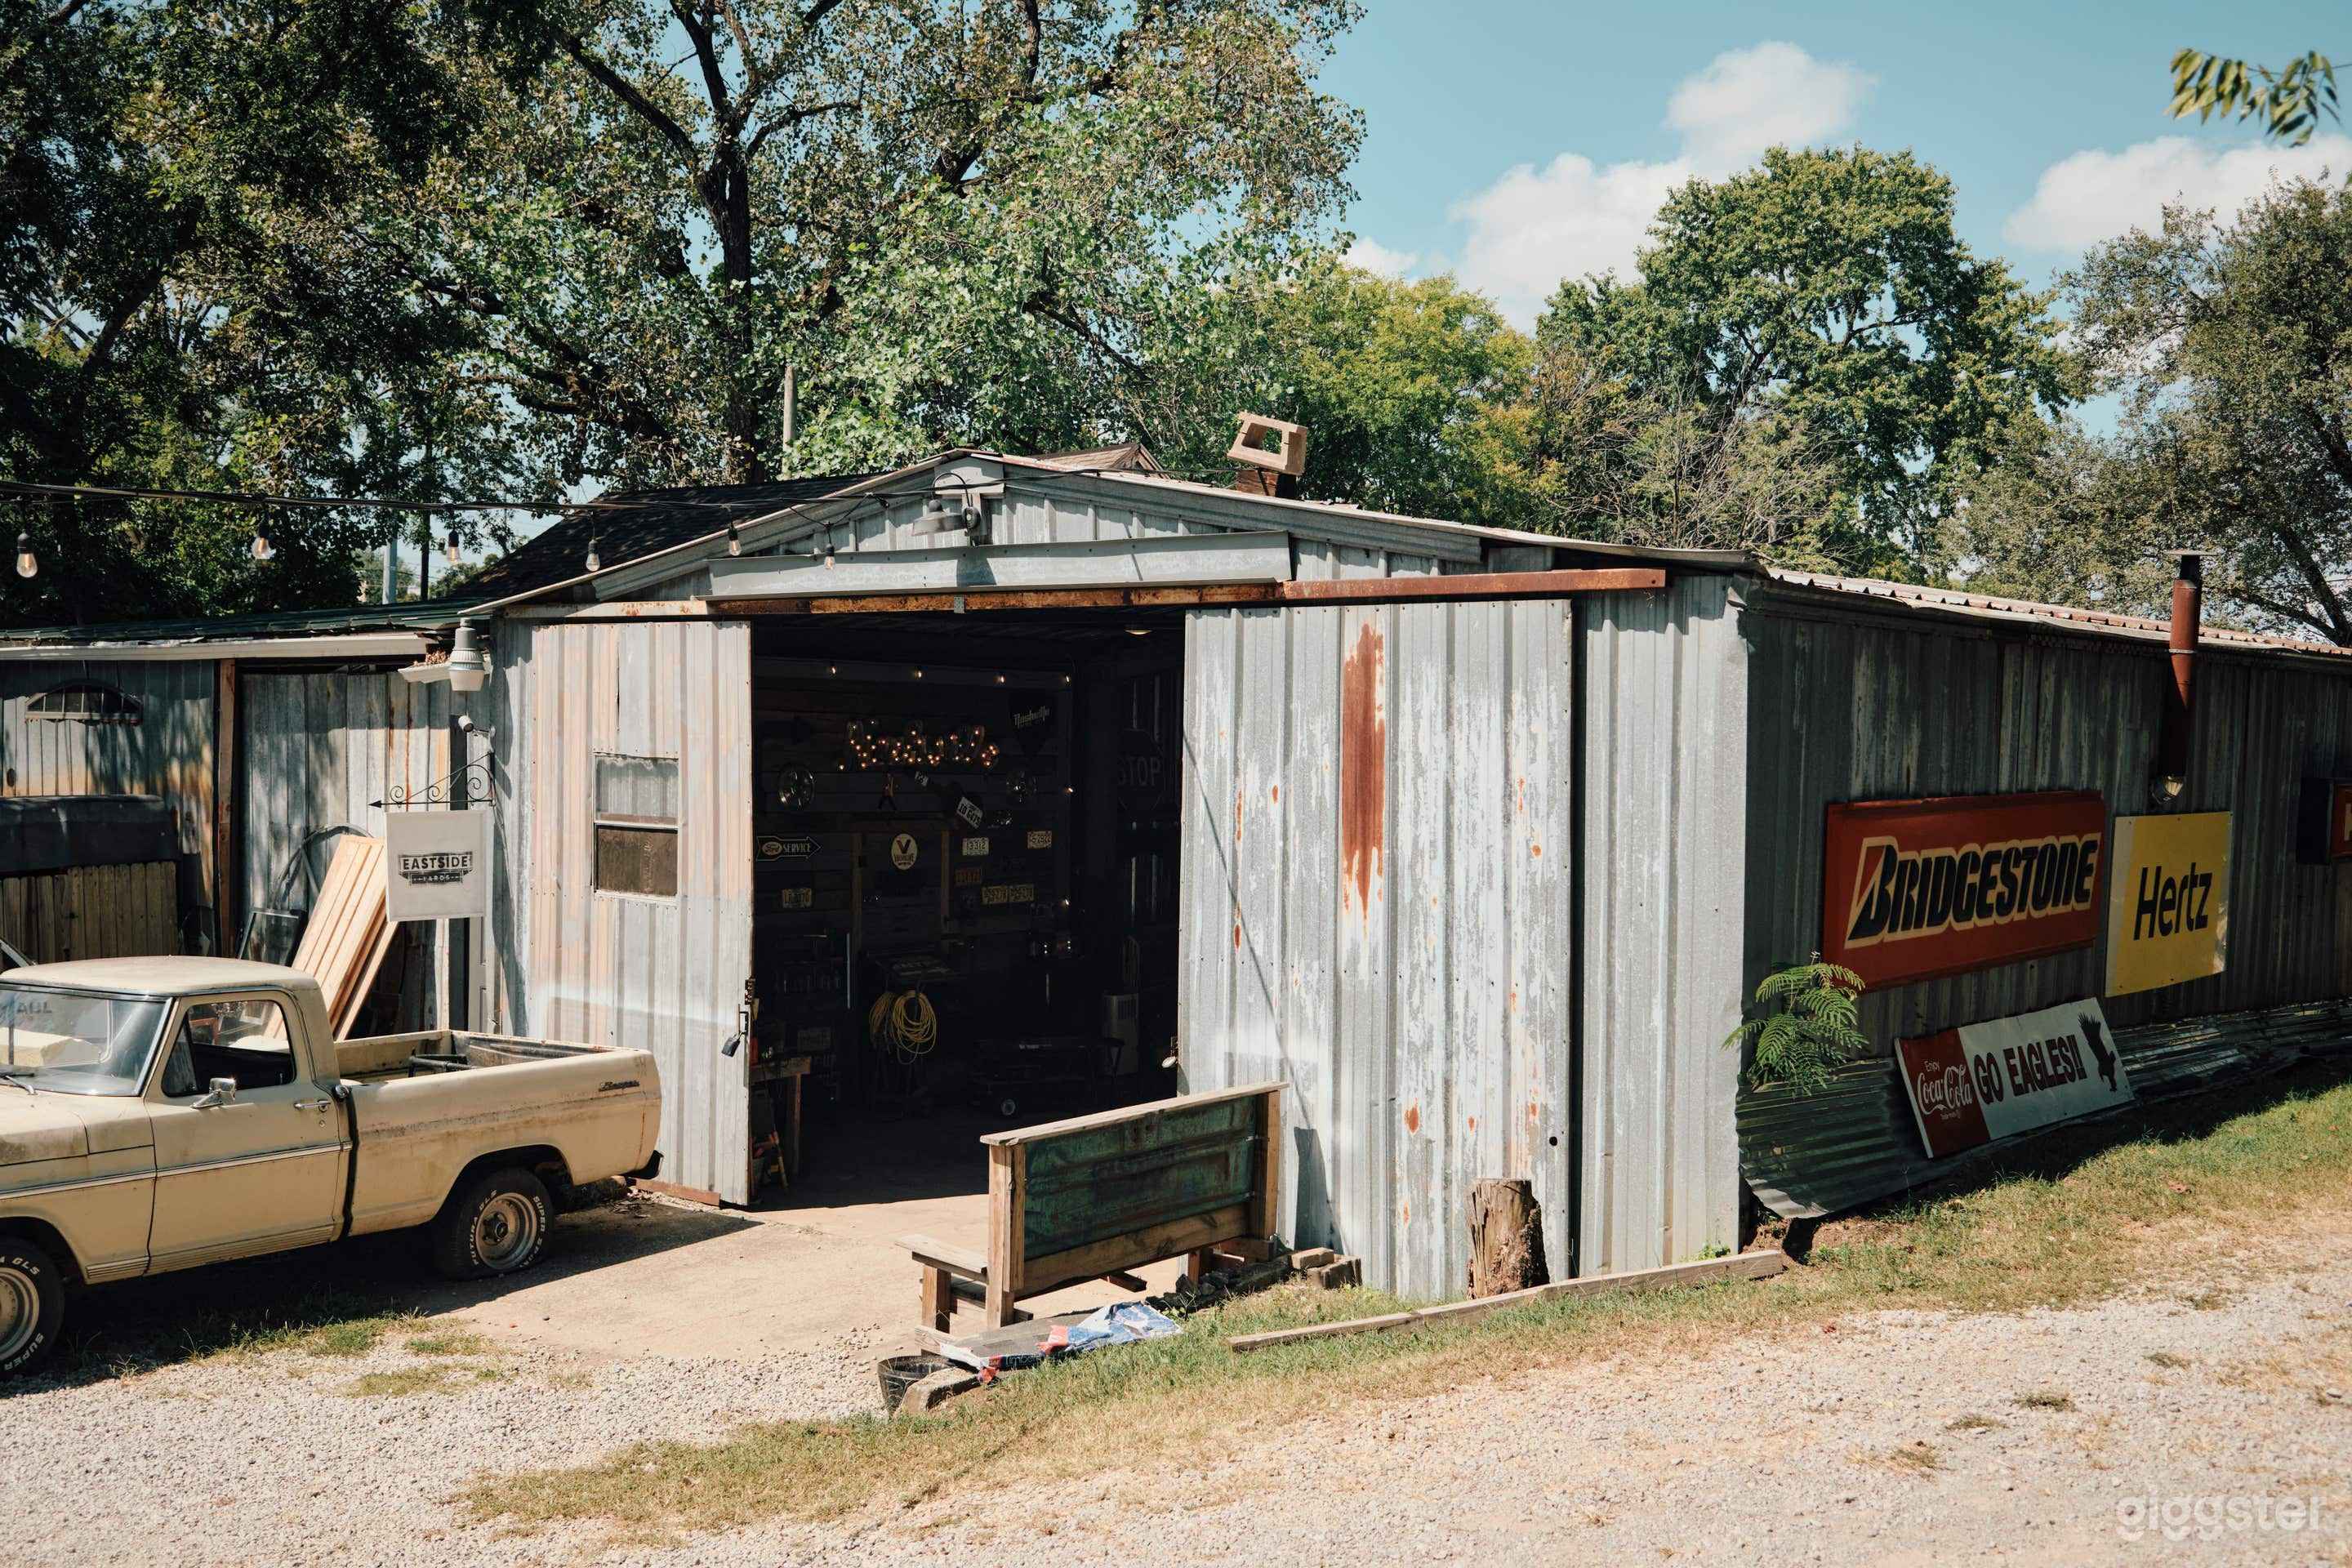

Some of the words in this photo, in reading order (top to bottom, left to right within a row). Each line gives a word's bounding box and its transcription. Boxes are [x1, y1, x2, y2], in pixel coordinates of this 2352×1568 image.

[403, 855, 469, 870] EASTSIDE
[783, 842, 811, 854] SERVICE
[1846, 837, 2100, 944] BRIDGESTONE
[2133, 862, 2213, 941] Hertz
[1925, 1060, 1940, 1072] Enjoy
[1974, 1052, 2004, 1104] GO
[2002, 1034, 2087, 1097] EAGLES!!
[532, 1196, 546, 1232] SUPER
[11, 1256, 41, 1276] GLS
[4, 1332, 45, 1371] SUPER
